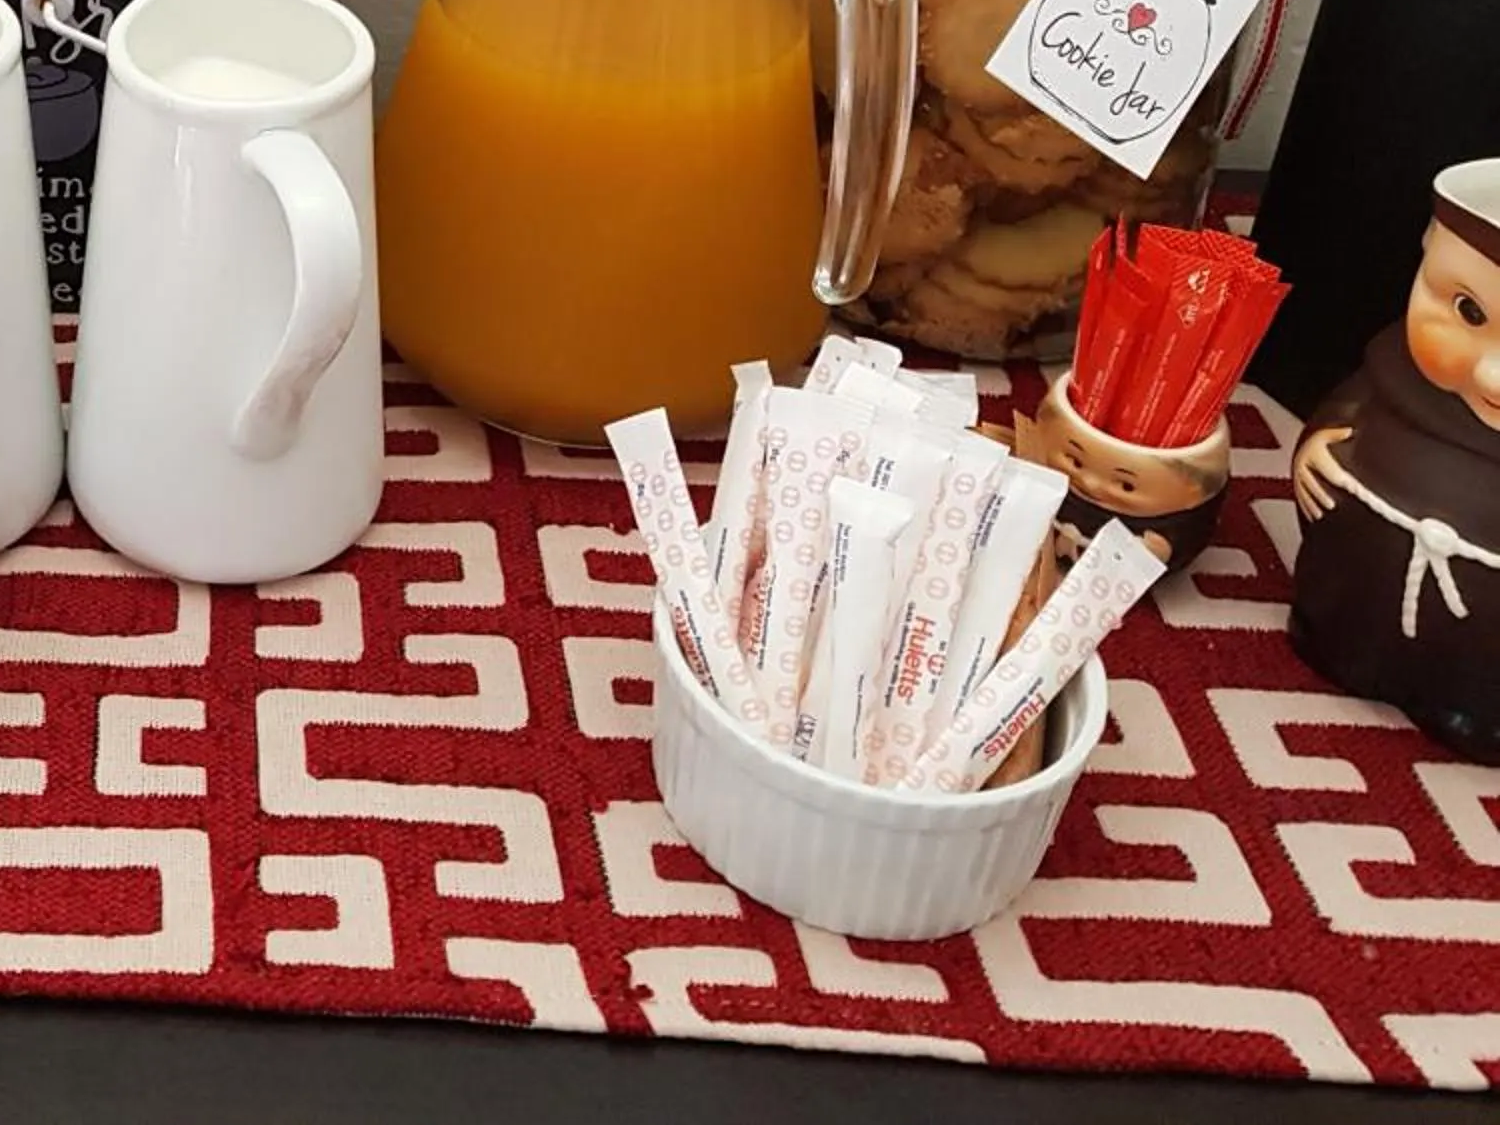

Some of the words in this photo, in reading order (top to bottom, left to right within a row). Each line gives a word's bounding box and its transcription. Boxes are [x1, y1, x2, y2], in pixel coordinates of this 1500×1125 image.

[1040, 11, 1114, 88] Cookie
[1109, 62, 1165, 123] Jar
[897, 615, 937, 699] Huletts
[983, 692, 1047, 758] Huletts
